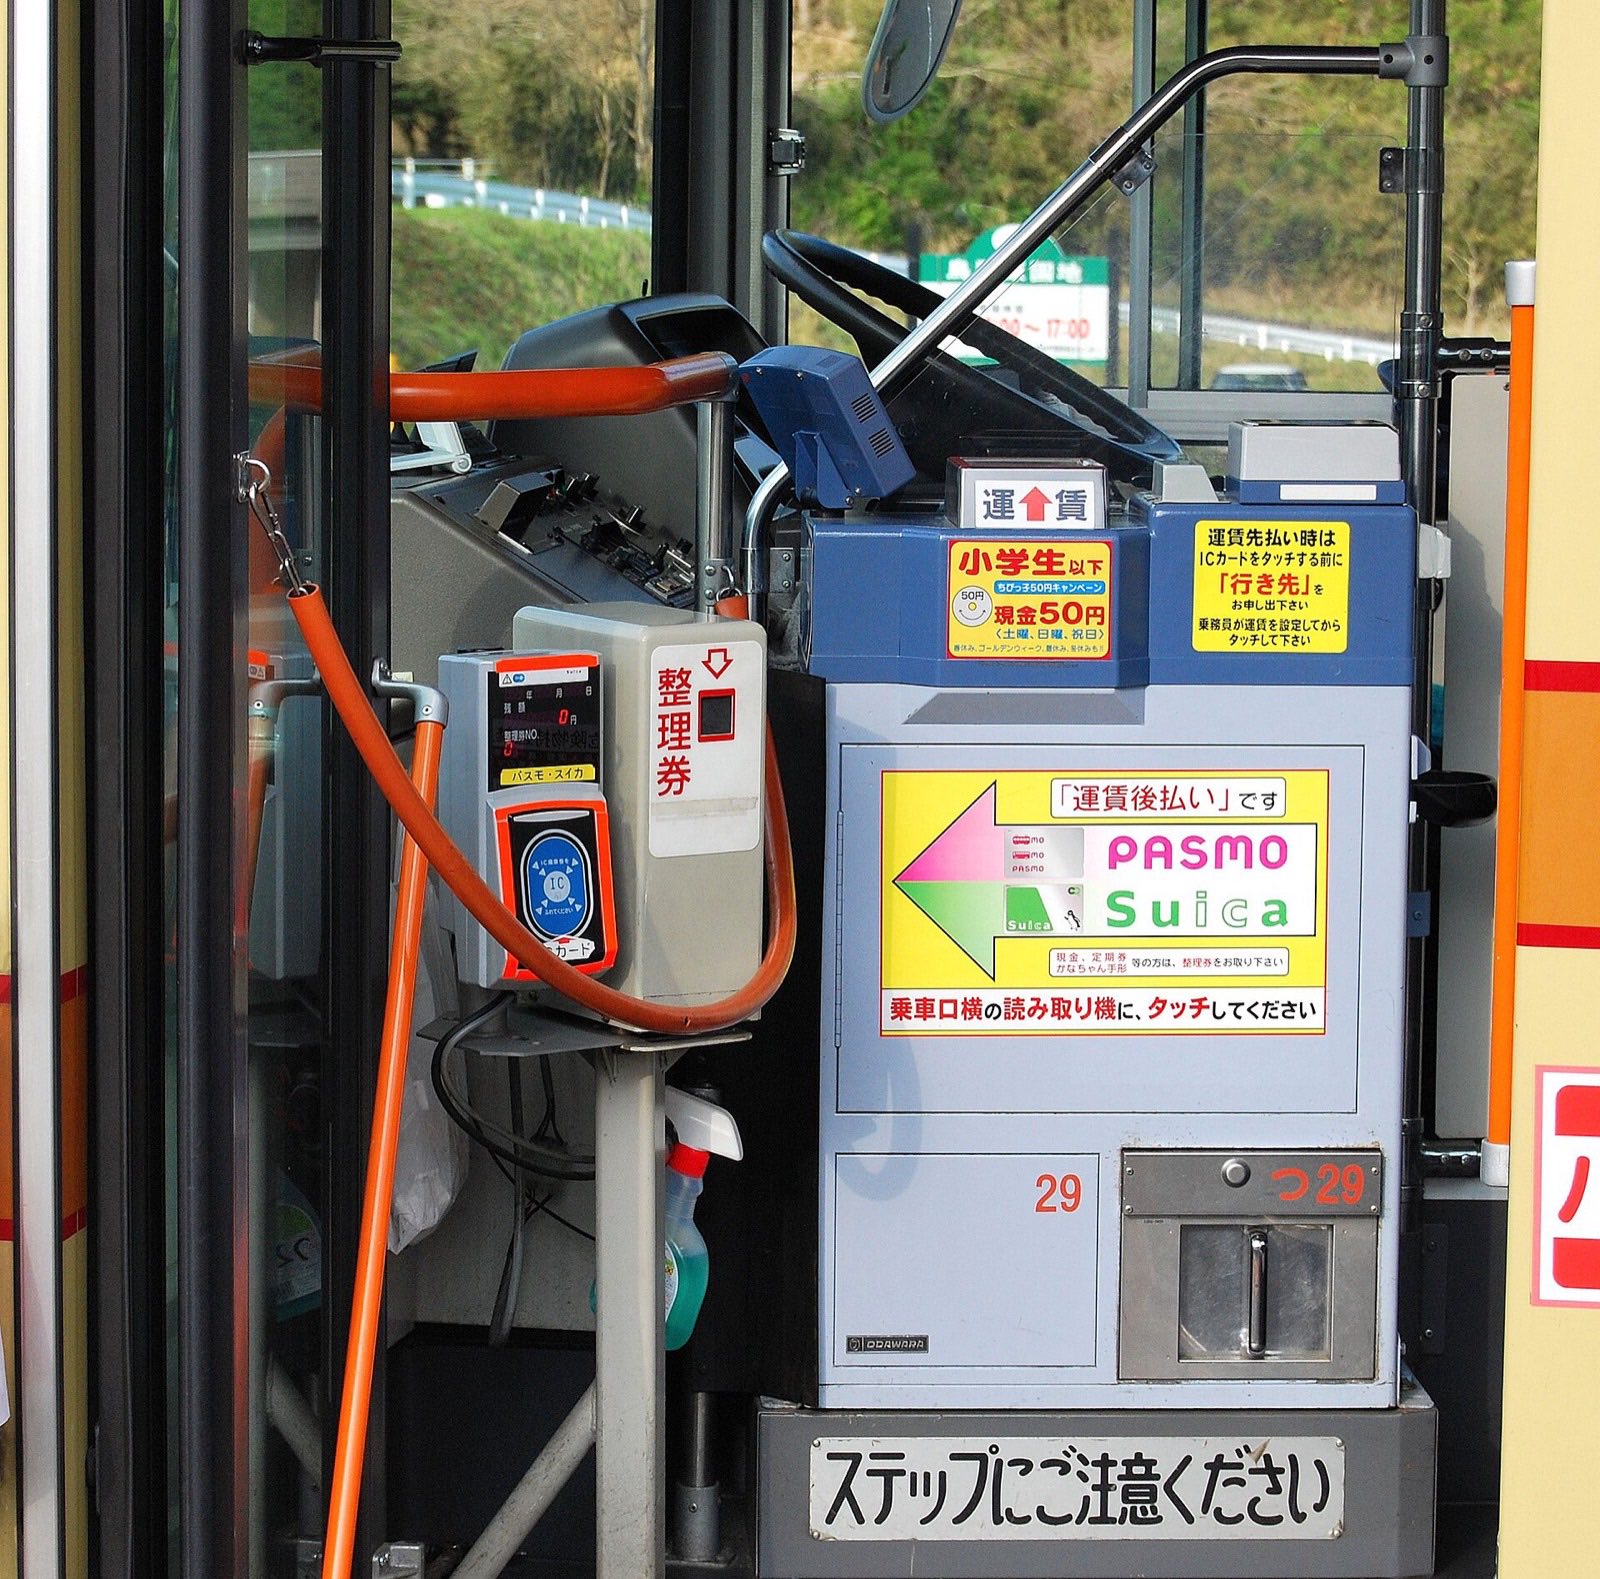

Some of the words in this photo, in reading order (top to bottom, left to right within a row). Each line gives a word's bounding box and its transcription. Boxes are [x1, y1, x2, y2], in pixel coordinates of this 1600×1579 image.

[983, 489, 1015, 520] 運
[1055, 489, 1087, 521] 賃
[1208, 528, 1336, 547] 運賃先払い時は
[958, 548, 1103, 576] 小学生以下
[1200, 551, 1343, 567] ICカードをタッチする前に
[961, 591, 984, 600] 50円
[997, 583, 1103, 593] ちびっ子50円キャンペーン
[994, 601, 1105, 626] 現金50円
[1231, 600, 1309, 611] お申し出下さい
[1198, 618, 1341, 632] 乗務員が運賃を設定してから
[1229, 634, 1311, 647] タッチして下さい
[657, 667, 692, 797] 整理券
[1061, 784, 1278, 812] 「運賃後払い」です
[1108, 835, 1288, 870] PASMO
[550, 876, 565, 890] IC
[1106, 890, 1288, 928] Suica
[1007, 920, 1051, 930] Suica
[547, 942, 591, 958] カード
[890, 996, 1316, 1022] 乗車口横の読み取り機に、タッチしてください
[1035, 1173, 1082, 1213] 29
[866, 1340, 924, 1349] ODAWARA
[824, 1443, 1331, 1526] ステップにご注意ください
